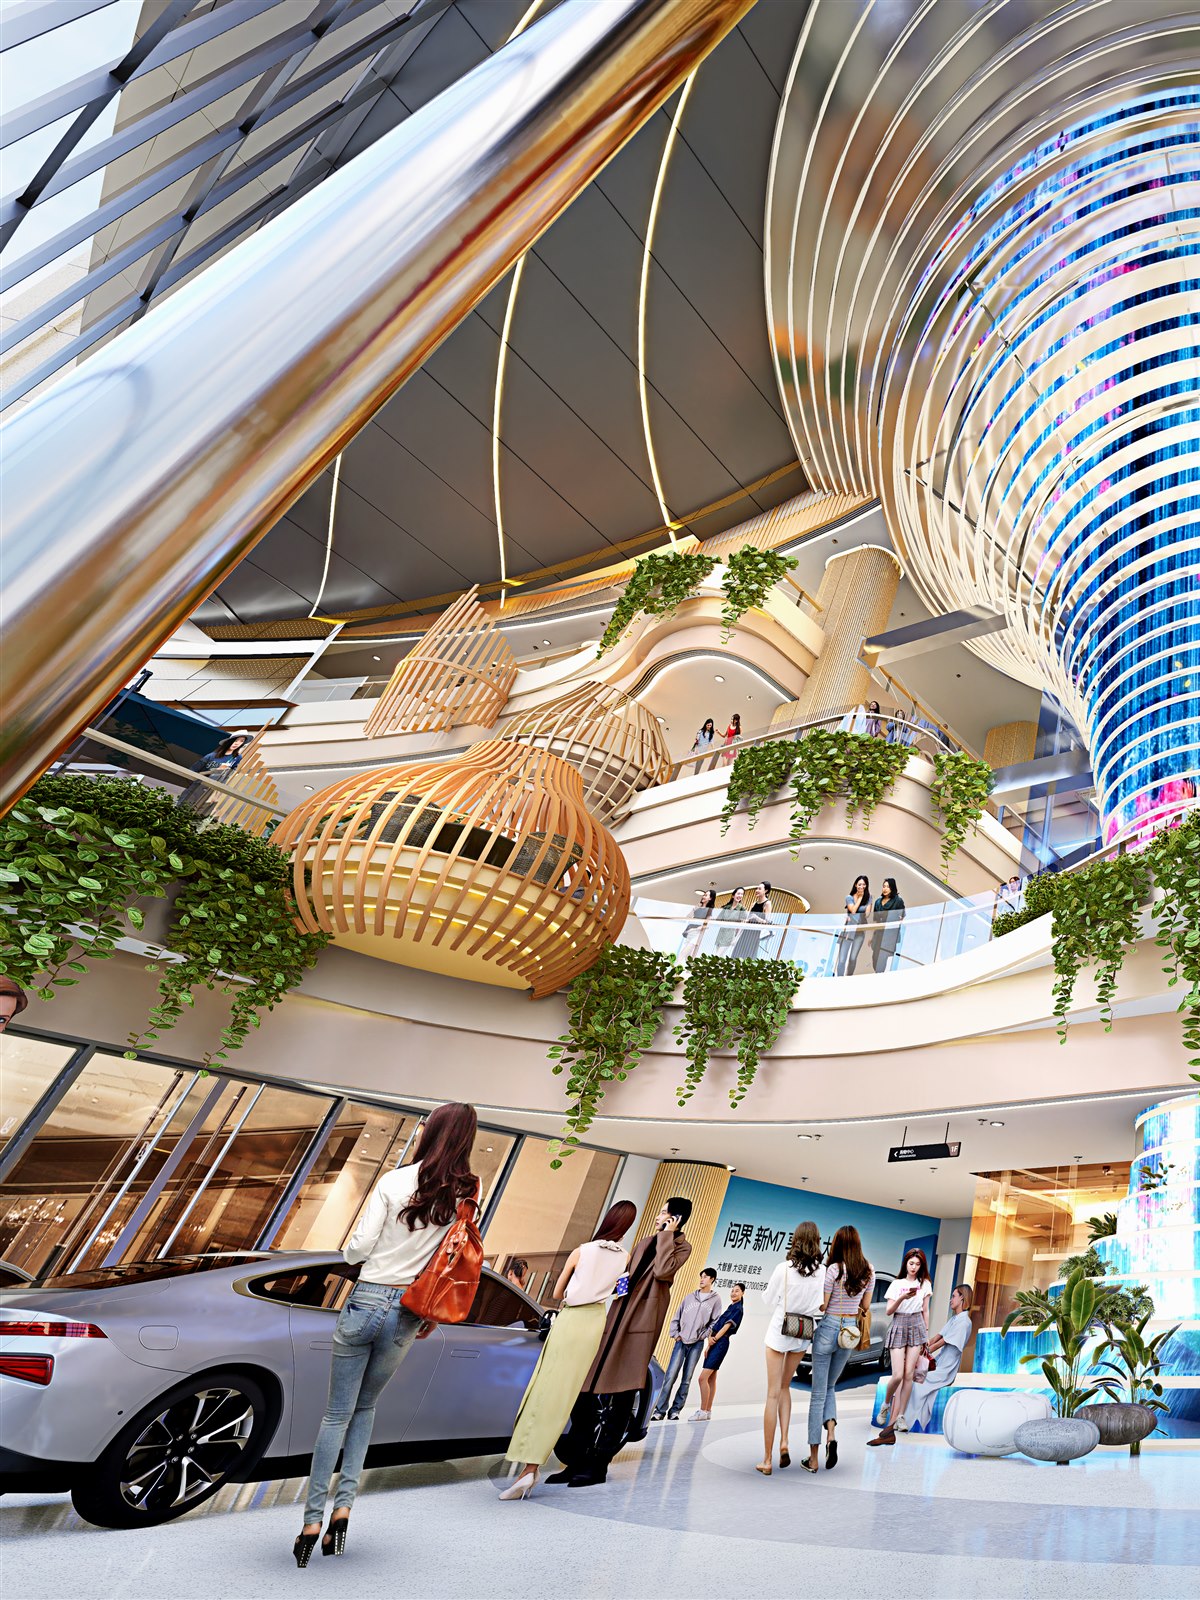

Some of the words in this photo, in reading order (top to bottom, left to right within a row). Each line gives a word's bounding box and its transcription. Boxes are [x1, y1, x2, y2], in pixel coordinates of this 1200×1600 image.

[951, 1145, 958, 1153] 1F
[723, 1221, 754, 1250] 问界
[752, 1226, 786, 1253] 新M7
